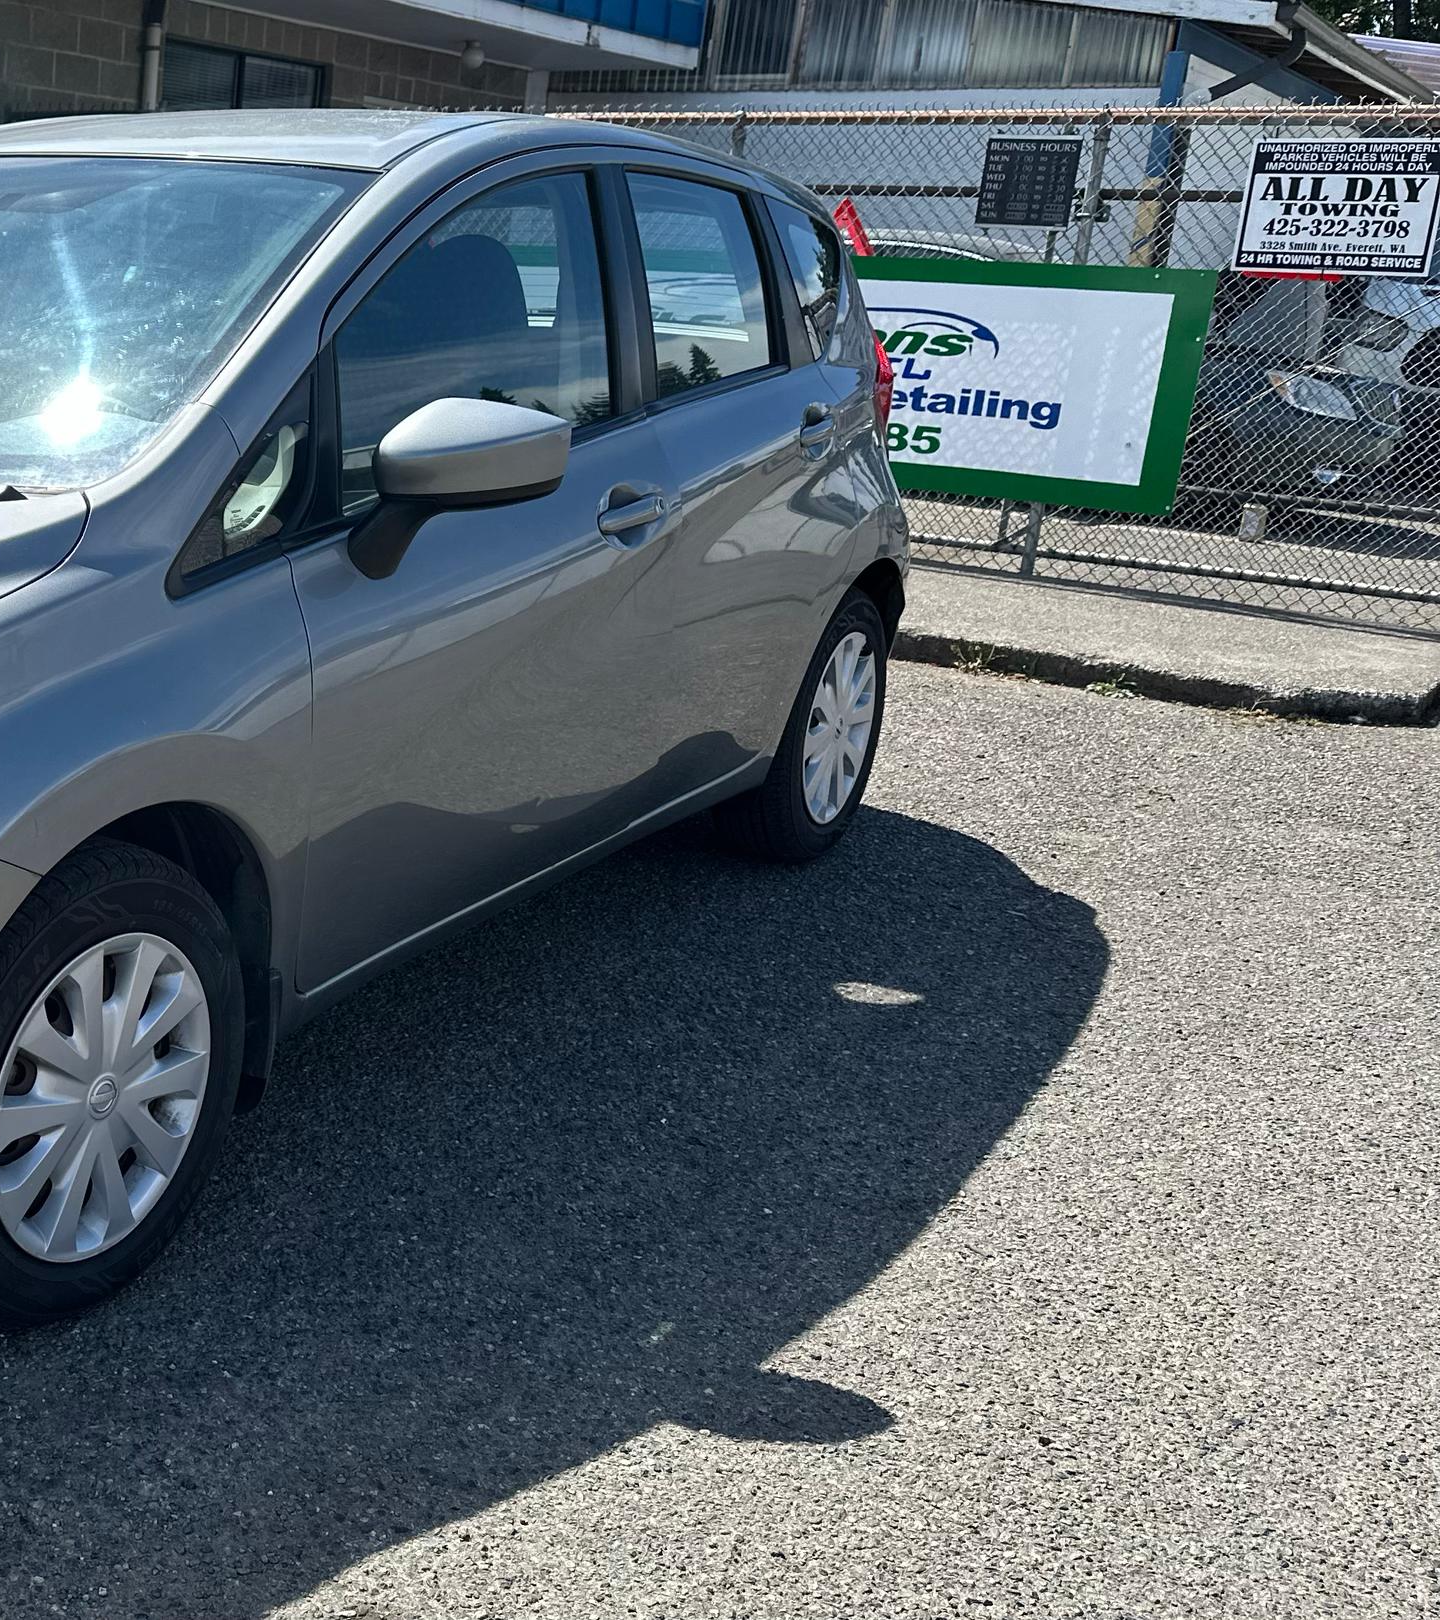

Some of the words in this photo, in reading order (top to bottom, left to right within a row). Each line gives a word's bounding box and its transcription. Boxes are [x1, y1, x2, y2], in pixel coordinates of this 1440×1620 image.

[990, 142, 1037, 151] BUSINESS
[1040, 143, 1078, 153] HOURS
[1260, 144, 1347, 153] UNAUTHORIZED
[1349, 144, 1367, 153] OR
[1368, 144, 1440, 153] IMPROPERL
[1273, 153, 1319, 162] PARKED
[1321, 153, 1377, 162] VEHICLES
[1380, 153, 1408, 162] WILL
[1410, 153, 1428, 162] BE
[1265, 162, 1332, 171] IMPOUNDED
[1335, 162, 1349, 171] 24
[1351, 162, 1394, 172] HOURS
[1395, 162, 1405, 171] A
[1407, 162, 1432, 172] DAY
[1260, 177, 1330, 201] ALL
[1342, 177, 1430, 203] DAY
[1280, 203, 1401, 217] TOWING
[1262, 218, 1410, 239] 425-322-3798
[1260, 241, 1285, 250] 3328
[1288, 241, 1318, 251] Smith
[1390, 244, 1406, 253] WA
[1239, 254, 1255, 264] 24
[1256, 254, 1273, 264] HR
[1277, 255, 1322, 266] TOWING
[1325, 256, 1333, 266] &
[1336, 256, 1368, 267] ROAD
[1371, 257, 1422, 268] SERVICE
